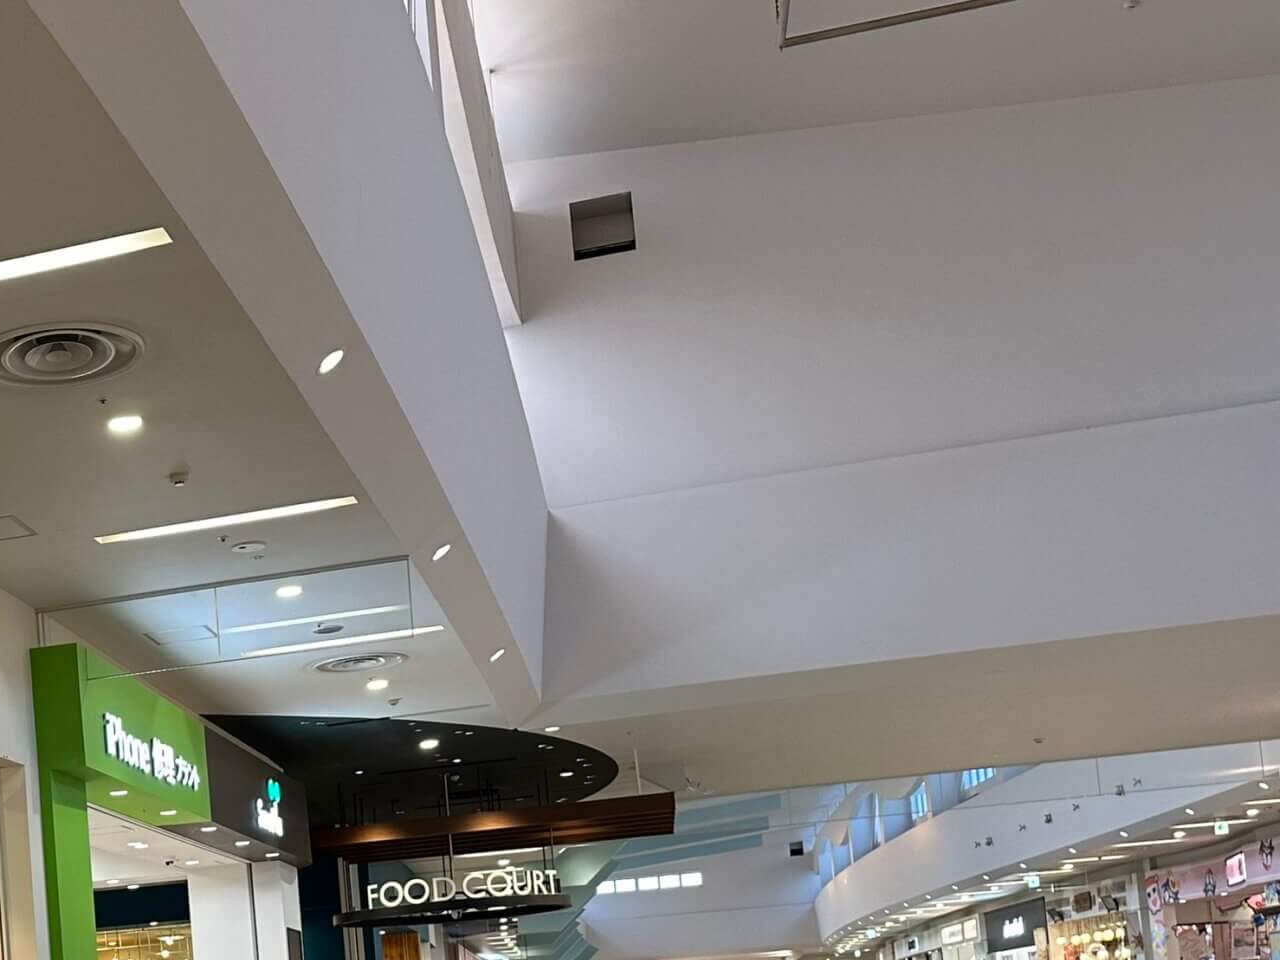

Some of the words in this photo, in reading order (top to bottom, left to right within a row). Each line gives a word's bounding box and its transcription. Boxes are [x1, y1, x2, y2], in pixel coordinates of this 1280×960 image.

[104, 712, 151, 775] iPhone
[367, 876, 456, 909] FOOD
[463, 869, 557, 899] COURT
